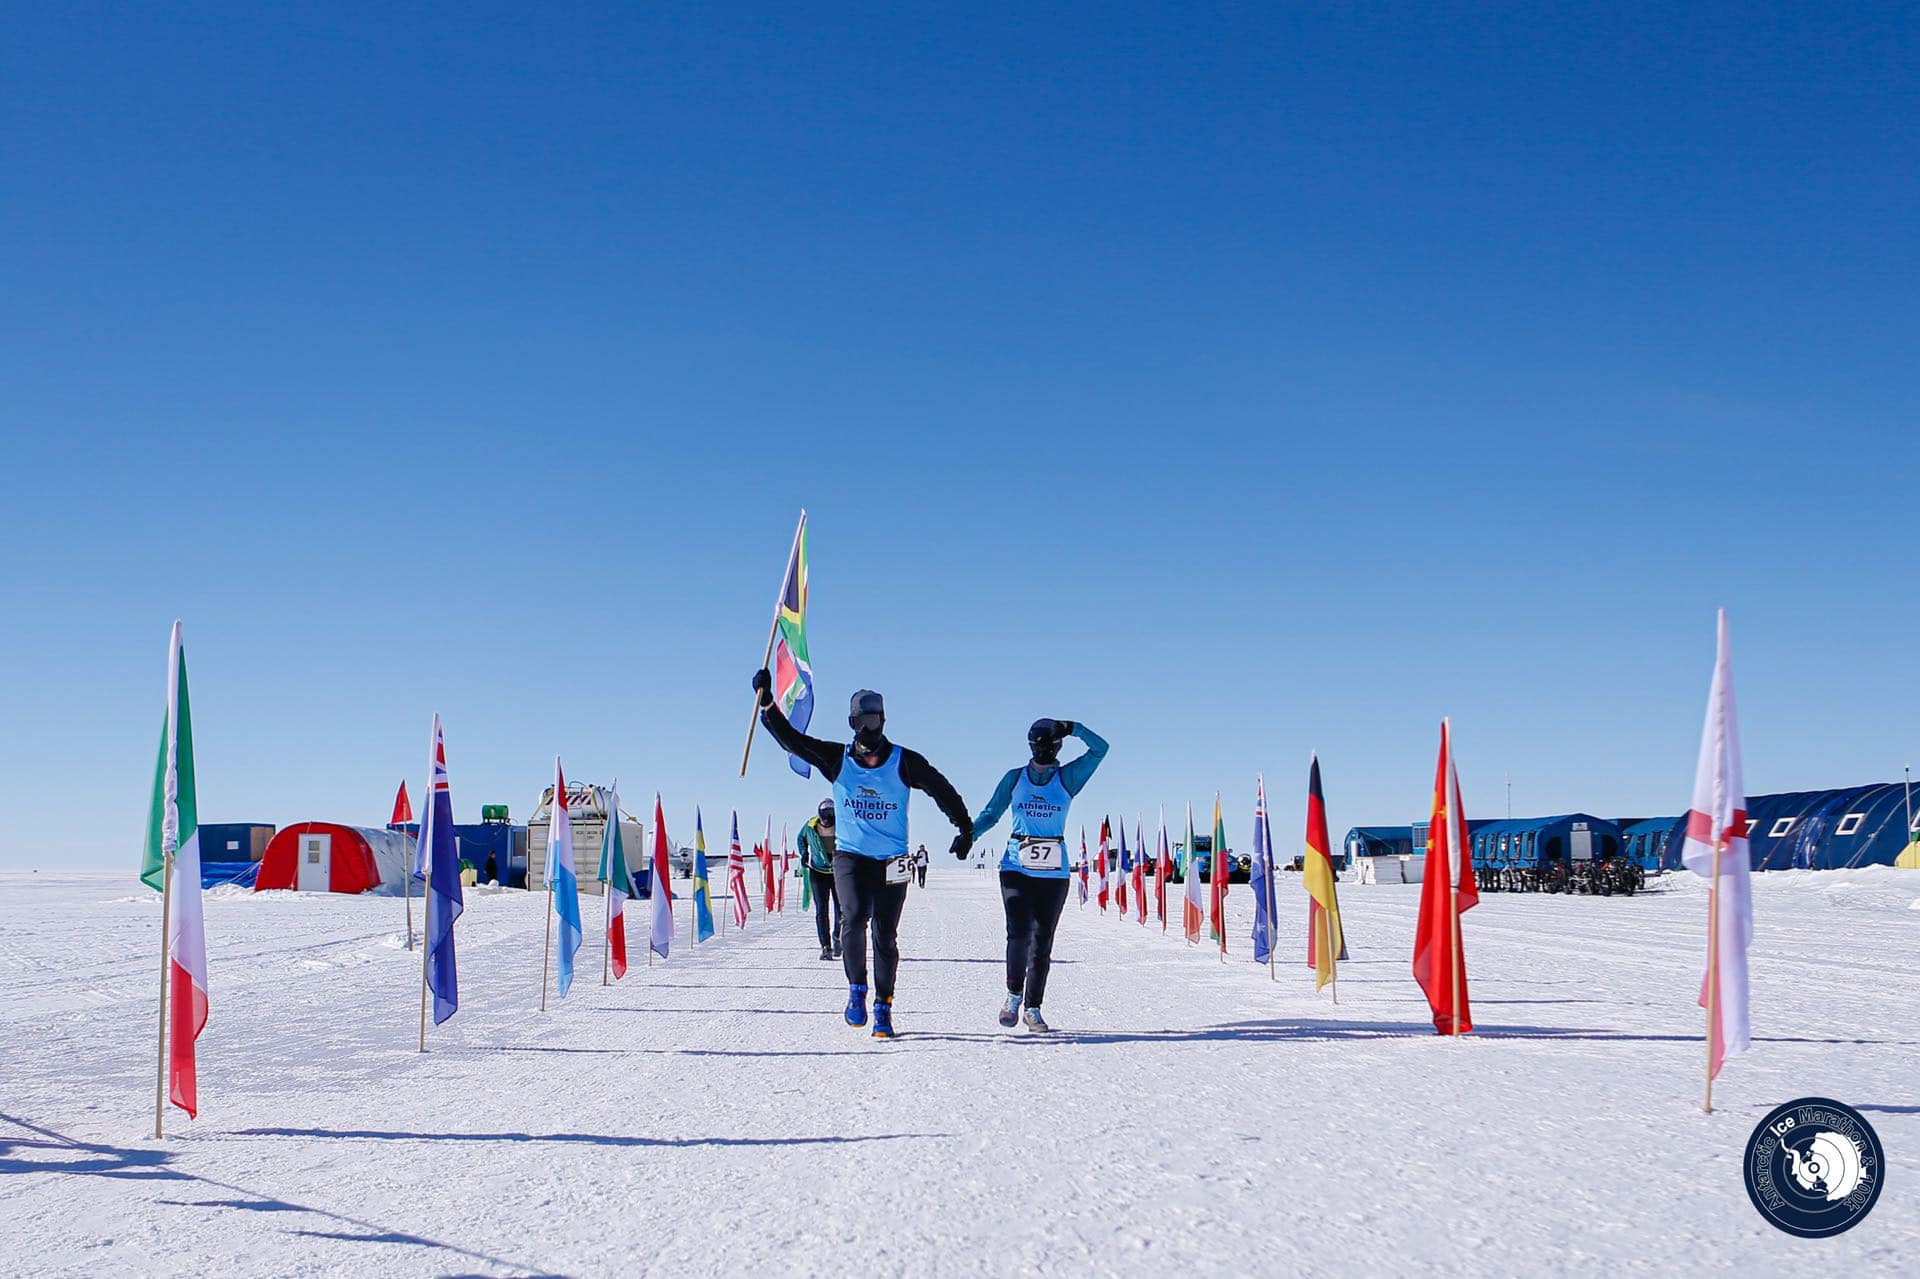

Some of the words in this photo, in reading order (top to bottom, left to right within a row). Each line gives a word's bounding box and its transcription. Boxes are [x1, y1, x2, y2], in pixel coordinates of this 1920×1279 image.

[844, 798, 898, 811] Athletics
[1017, 802, 1062, 812] Athletics
[854, 809, 889, 821] Kloof
[1026, 810, 1053, 818] Kloof
[1030, 846, 1052, 860] 57
